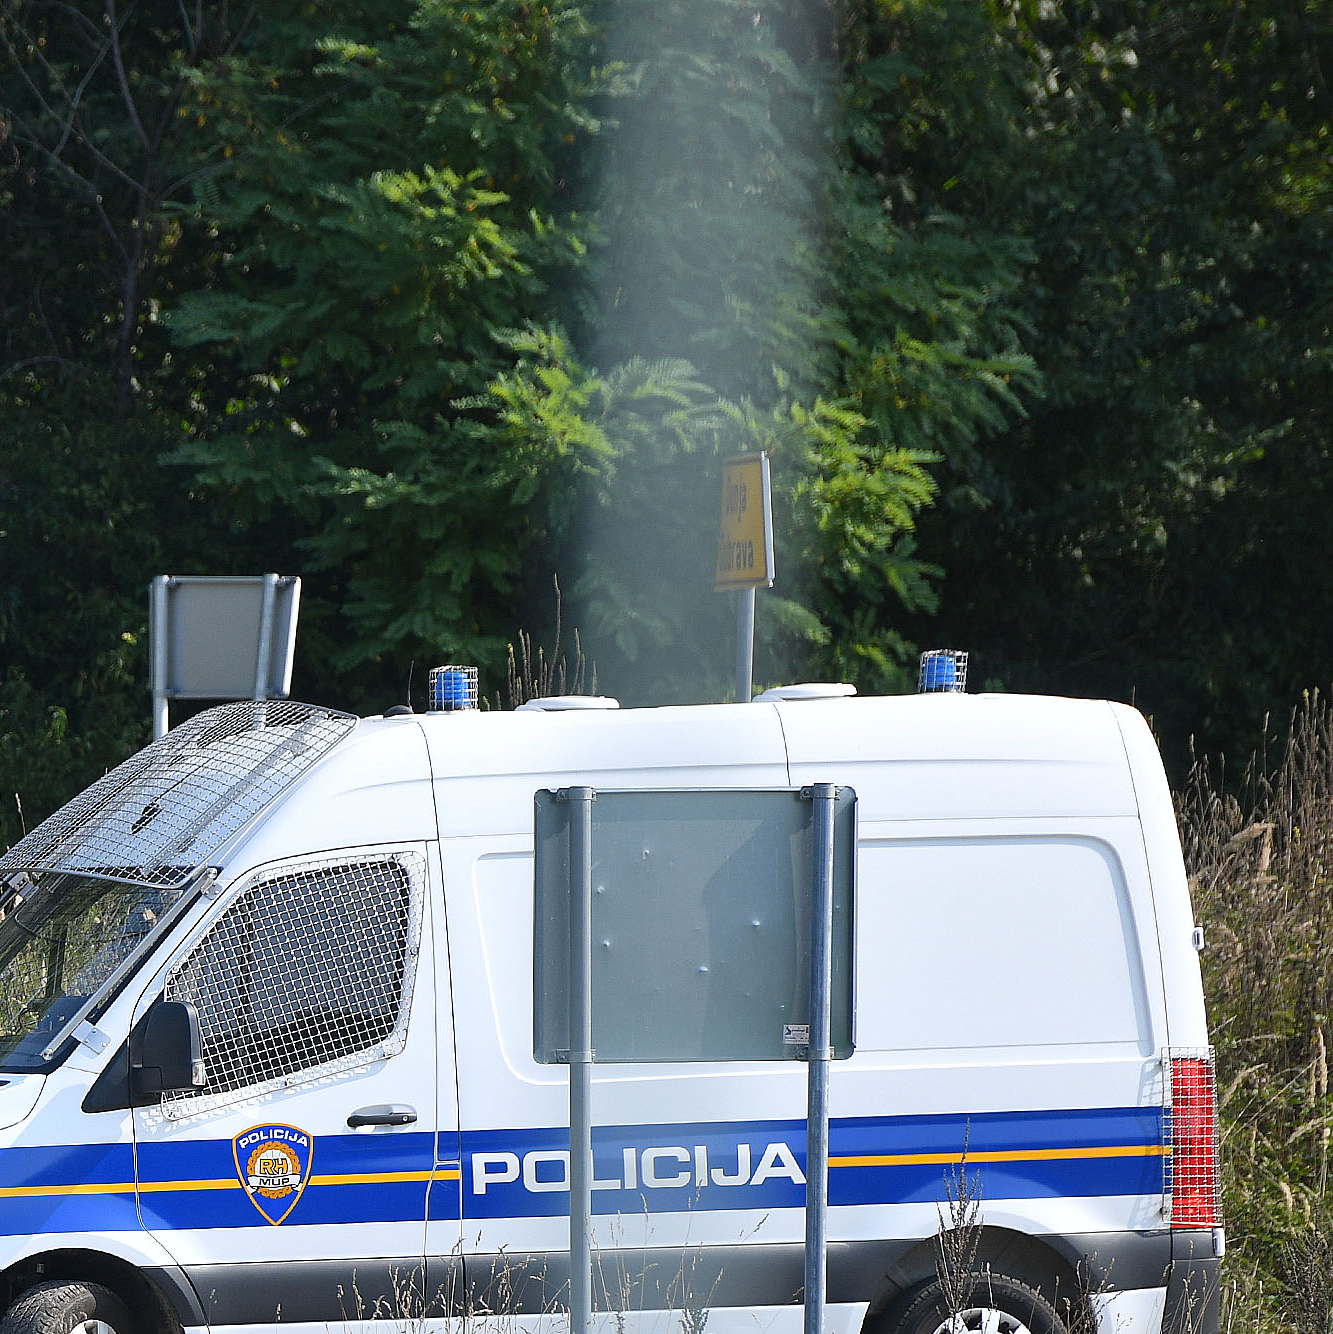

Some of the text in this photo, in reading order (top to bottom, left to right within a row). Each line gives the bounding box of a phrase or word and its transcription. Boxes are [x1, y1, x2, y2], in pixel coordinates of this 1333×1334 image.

[238, 1128, 308, 1149] POLICIJA
[259, 1158, 288, 1175] RH
[471, 1142, 807, 1195] POLICIJA
[259, 1177, 290, 1186] MUP
